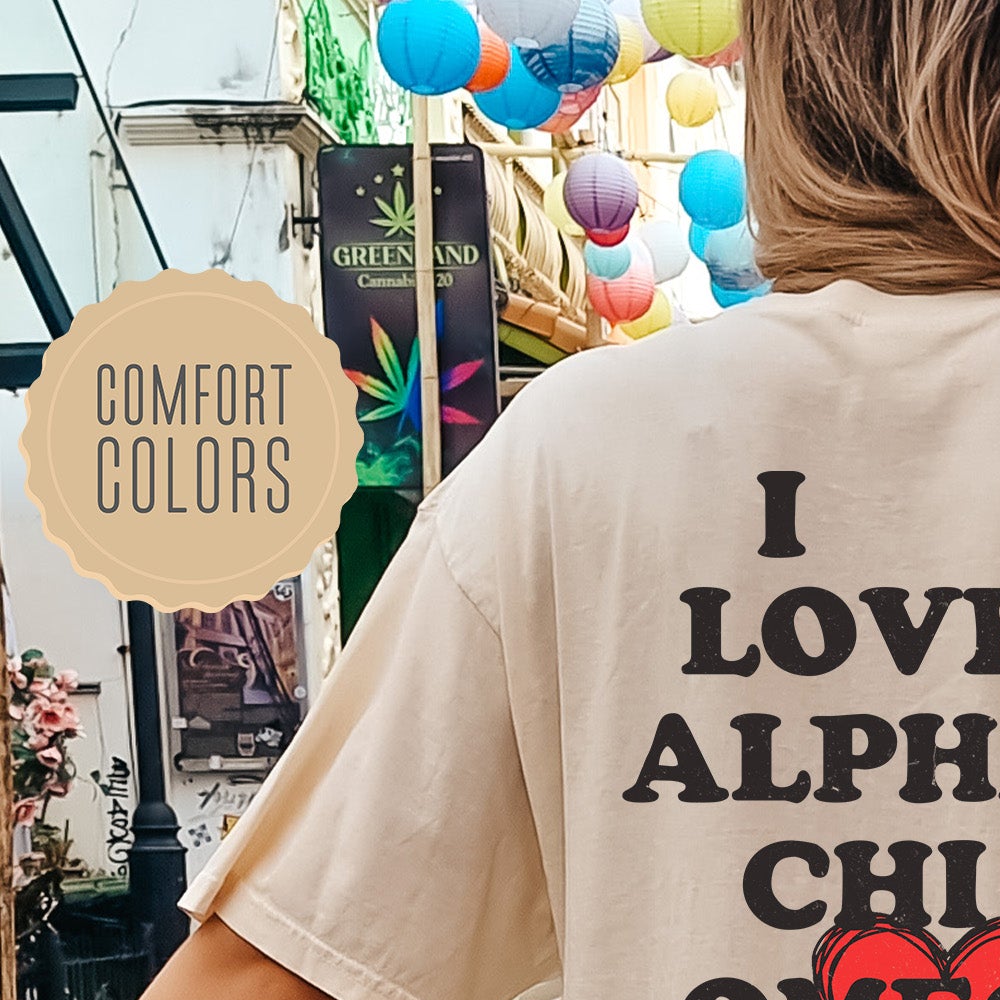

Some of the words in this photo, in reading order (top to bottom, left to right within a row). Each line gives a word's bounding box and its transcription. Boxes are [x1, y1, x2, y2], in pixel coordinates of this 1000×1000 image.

[332, 243, 480, 268] GREENAND
[434, 273, 454, 288] 20
[756, 470, 807, 558] I
[742, 839, 988, 930] CHI
